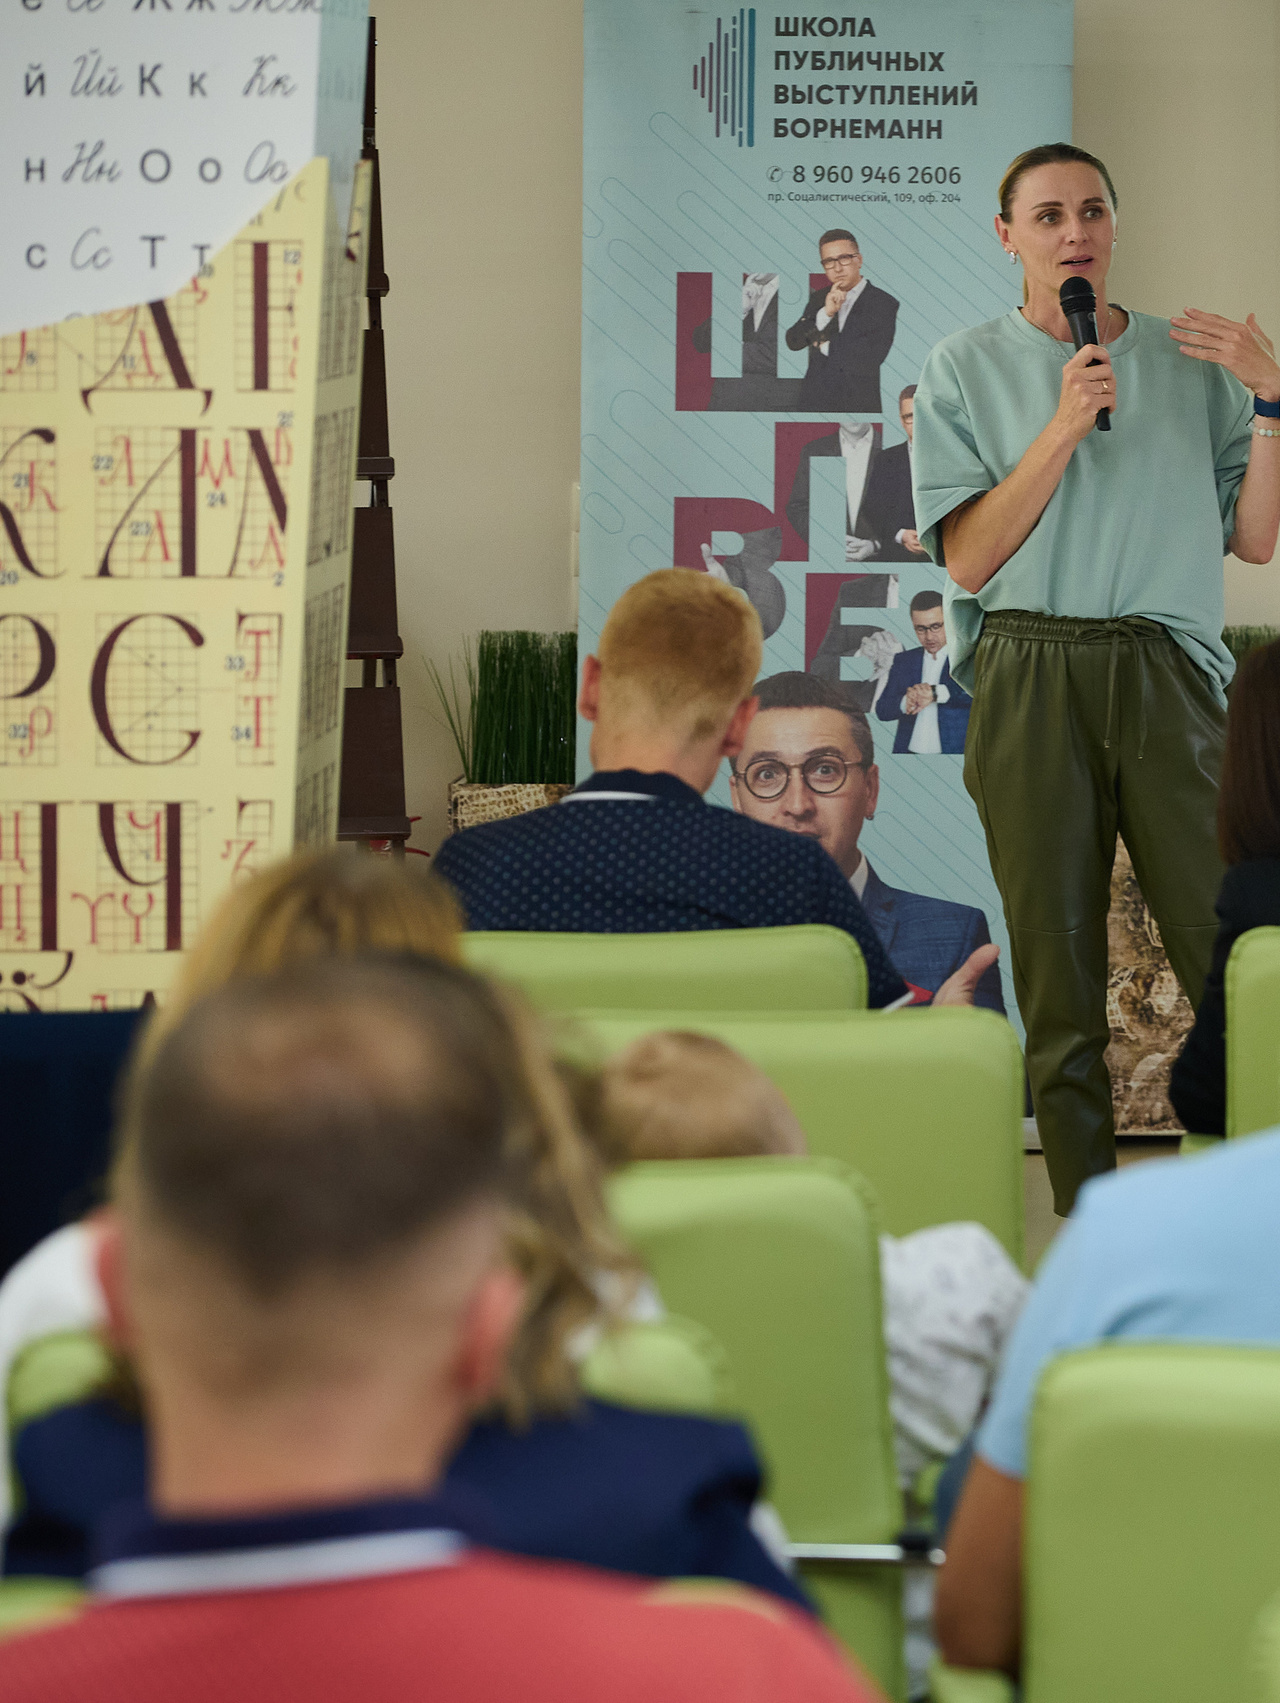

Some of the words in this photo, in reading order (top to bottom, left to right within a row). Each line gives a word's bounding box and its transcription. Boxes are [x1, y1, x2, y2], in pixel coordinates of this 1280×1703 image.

[773, 17, 876, 38] ШКОЛА
[773, 51, 945, 72] ПУБЛИЧНЫХ
[773, 80, 979, 106] ВЫСТУПЛЕНИЙ
[772, 117, 943, 139] БОРНЕМАНН
[792, 165, 806, 183] 8
[813, 165, 854, 184] 960
[860, 165, 901, 184] 946
[907, 166, 962, 185] 2606
[767, 193, 785, 204] пр.
[894, 193, 915, 204] 109,
[918, 192, 938, 205] оф.
[941, 193, 962, 203] 204
